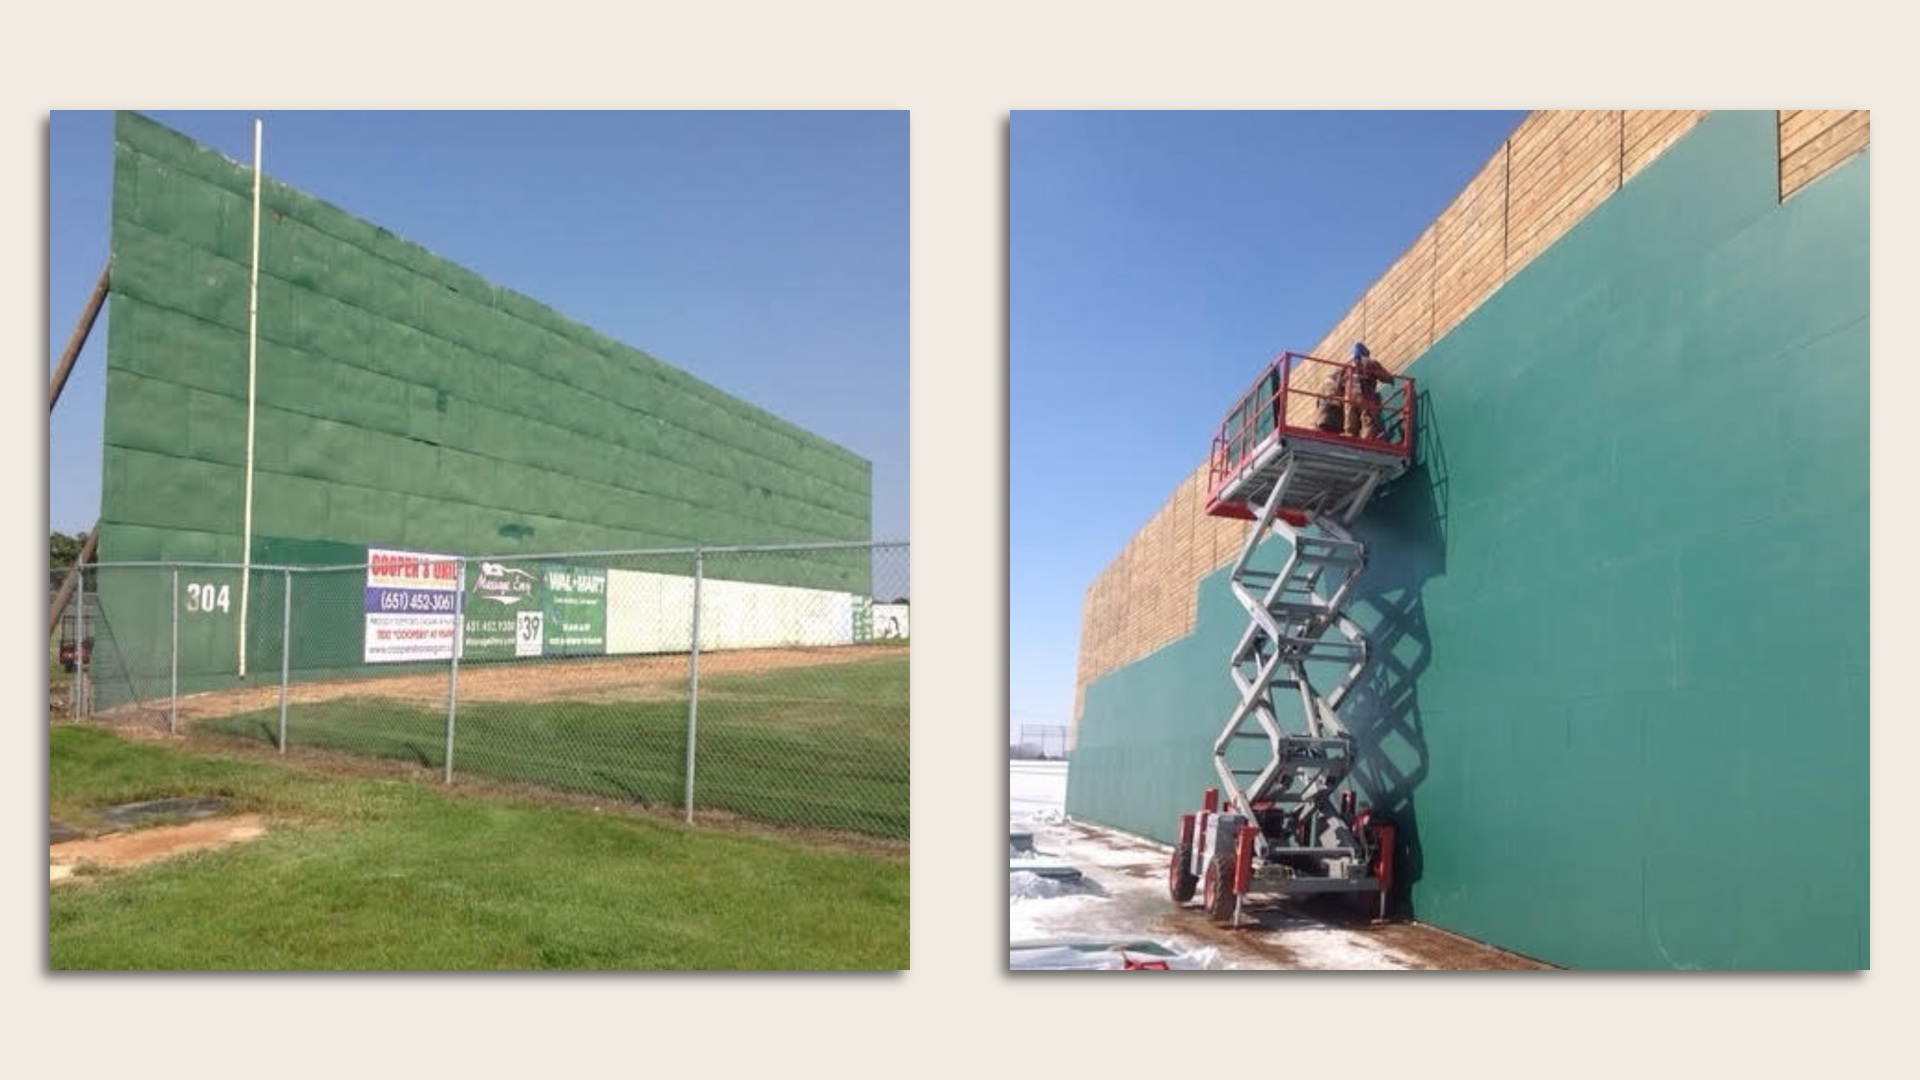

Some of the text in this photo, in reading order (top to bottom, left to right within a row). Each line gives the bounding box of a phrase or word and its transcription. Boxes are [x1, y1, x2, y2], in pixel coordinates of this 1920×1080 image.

[434, 560, 457, 580] GRIL
[187, 583, 230, 614] 304
[381, 590, 408, 610] (651)
